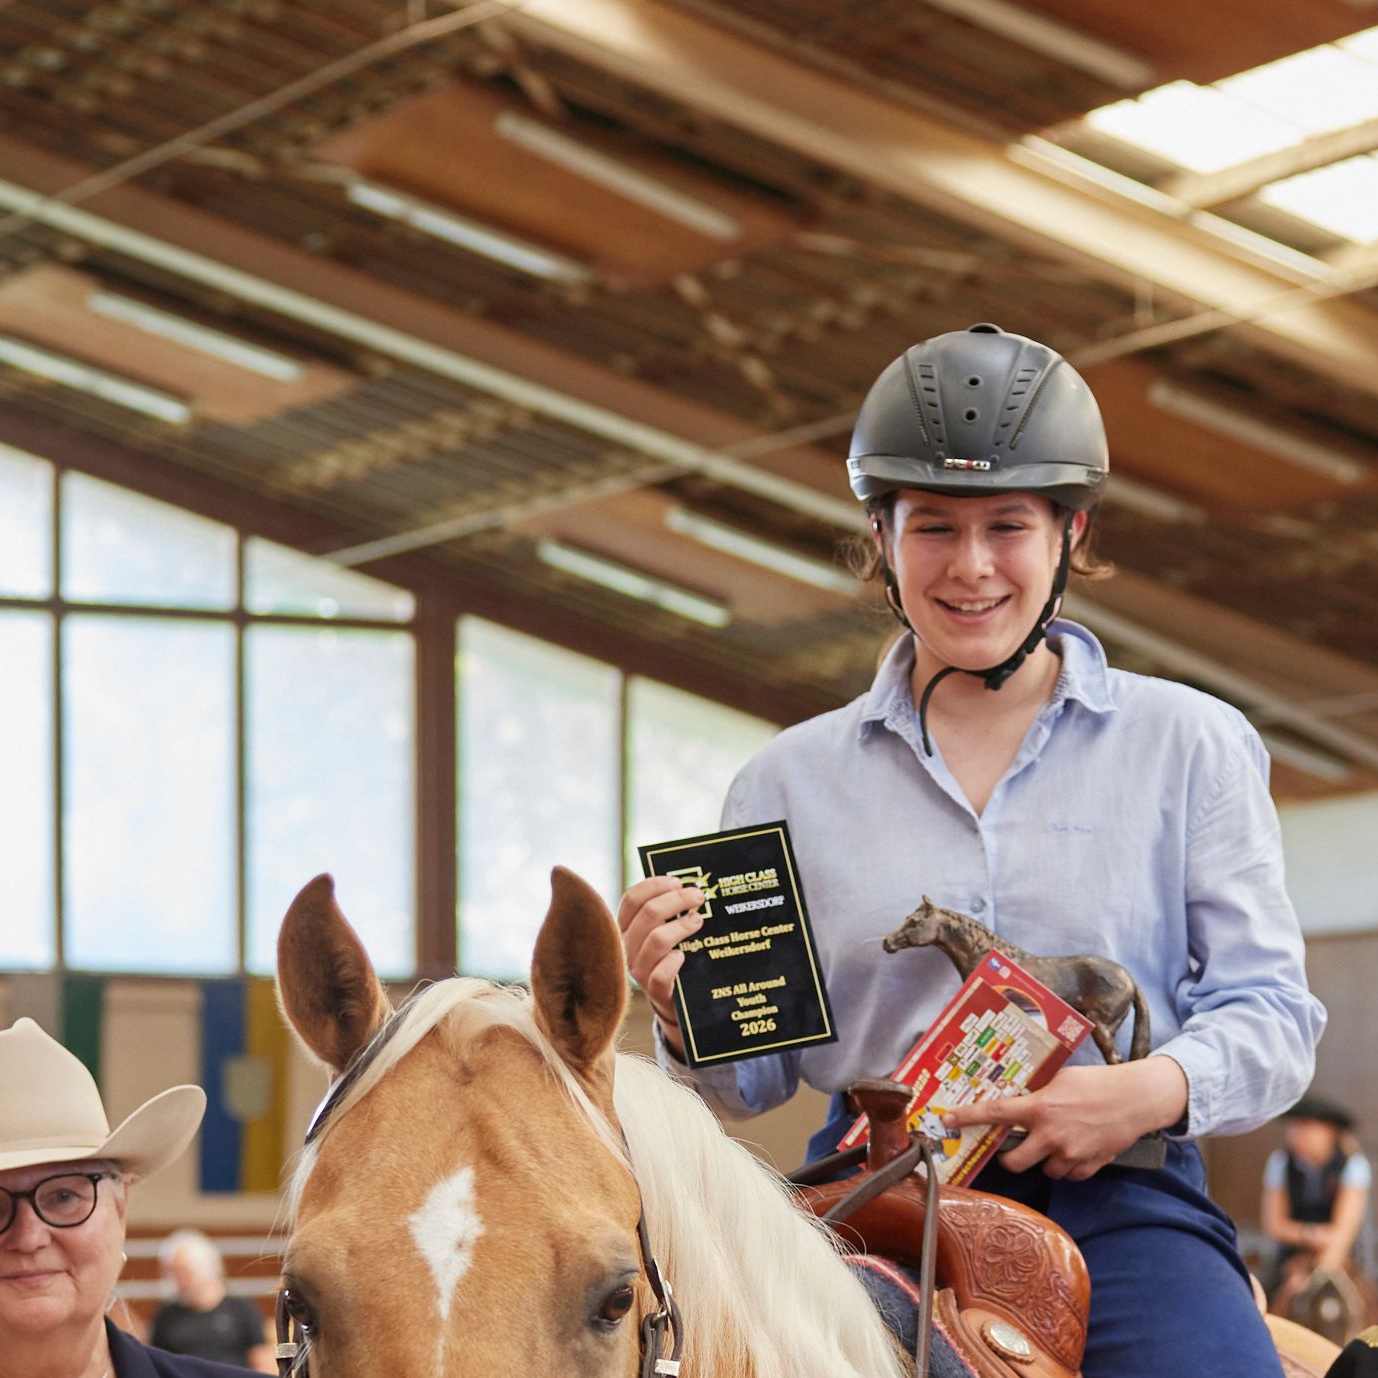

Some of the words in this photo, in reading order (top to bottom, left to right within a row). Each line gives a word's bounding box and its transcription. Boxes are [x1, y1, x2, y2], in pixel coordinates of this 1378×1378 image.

[718, 875, 744, 887] HIGH
[745, 869, 777, 881] CLASS
[679, 940, 702, 951] High
[703, 936, 729, 947] Class
[730, 931, 759, 942] Horse
[761, 924, 794, 936] Center
[708, 939, 770, 959] Weikersdorf
[711, 987, 732, 999] ZNS
[733, 983, 747, 994] All
[748, 976, 786, 991] Around
[736, 994, 766, 1006] Youth
[731, 1006, 778, 1020] Champion
[740, 1019, 776, 1035] 2026
